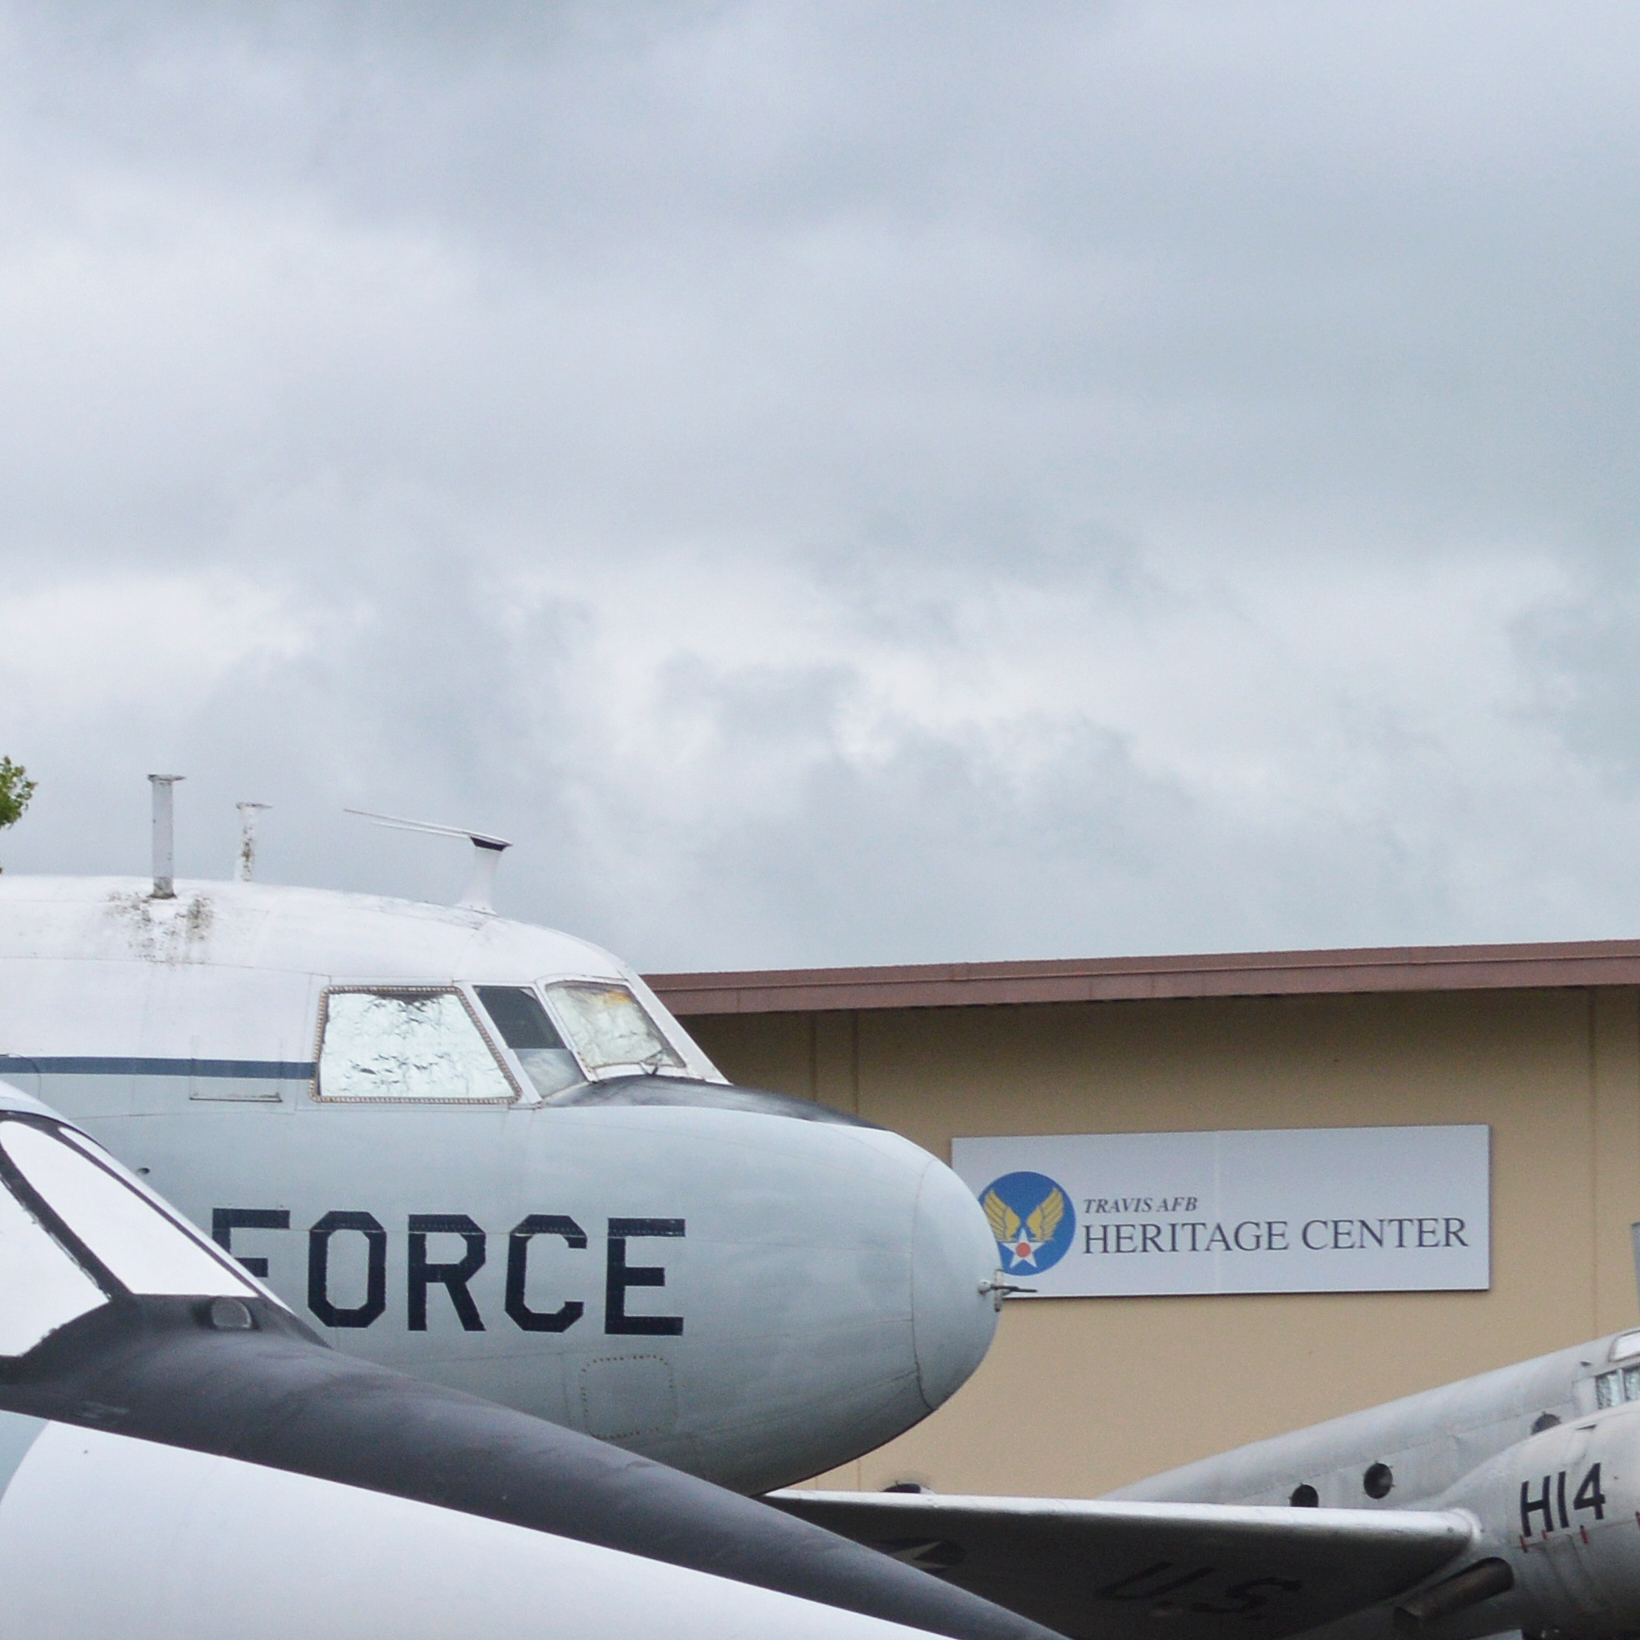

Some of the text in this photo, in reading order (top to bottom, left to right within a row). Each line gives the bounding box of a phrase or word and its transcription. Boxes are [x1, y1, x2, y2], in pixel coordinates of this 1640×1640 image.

[1083, 1196, 1199, 1214] TRAVIS AFB
[1081, 1217, 1470, 1254] HERITAGE CENTER
[212, 1207, 686, 1336] FORCE
[1520, 1462, 1607, 1538] H14
